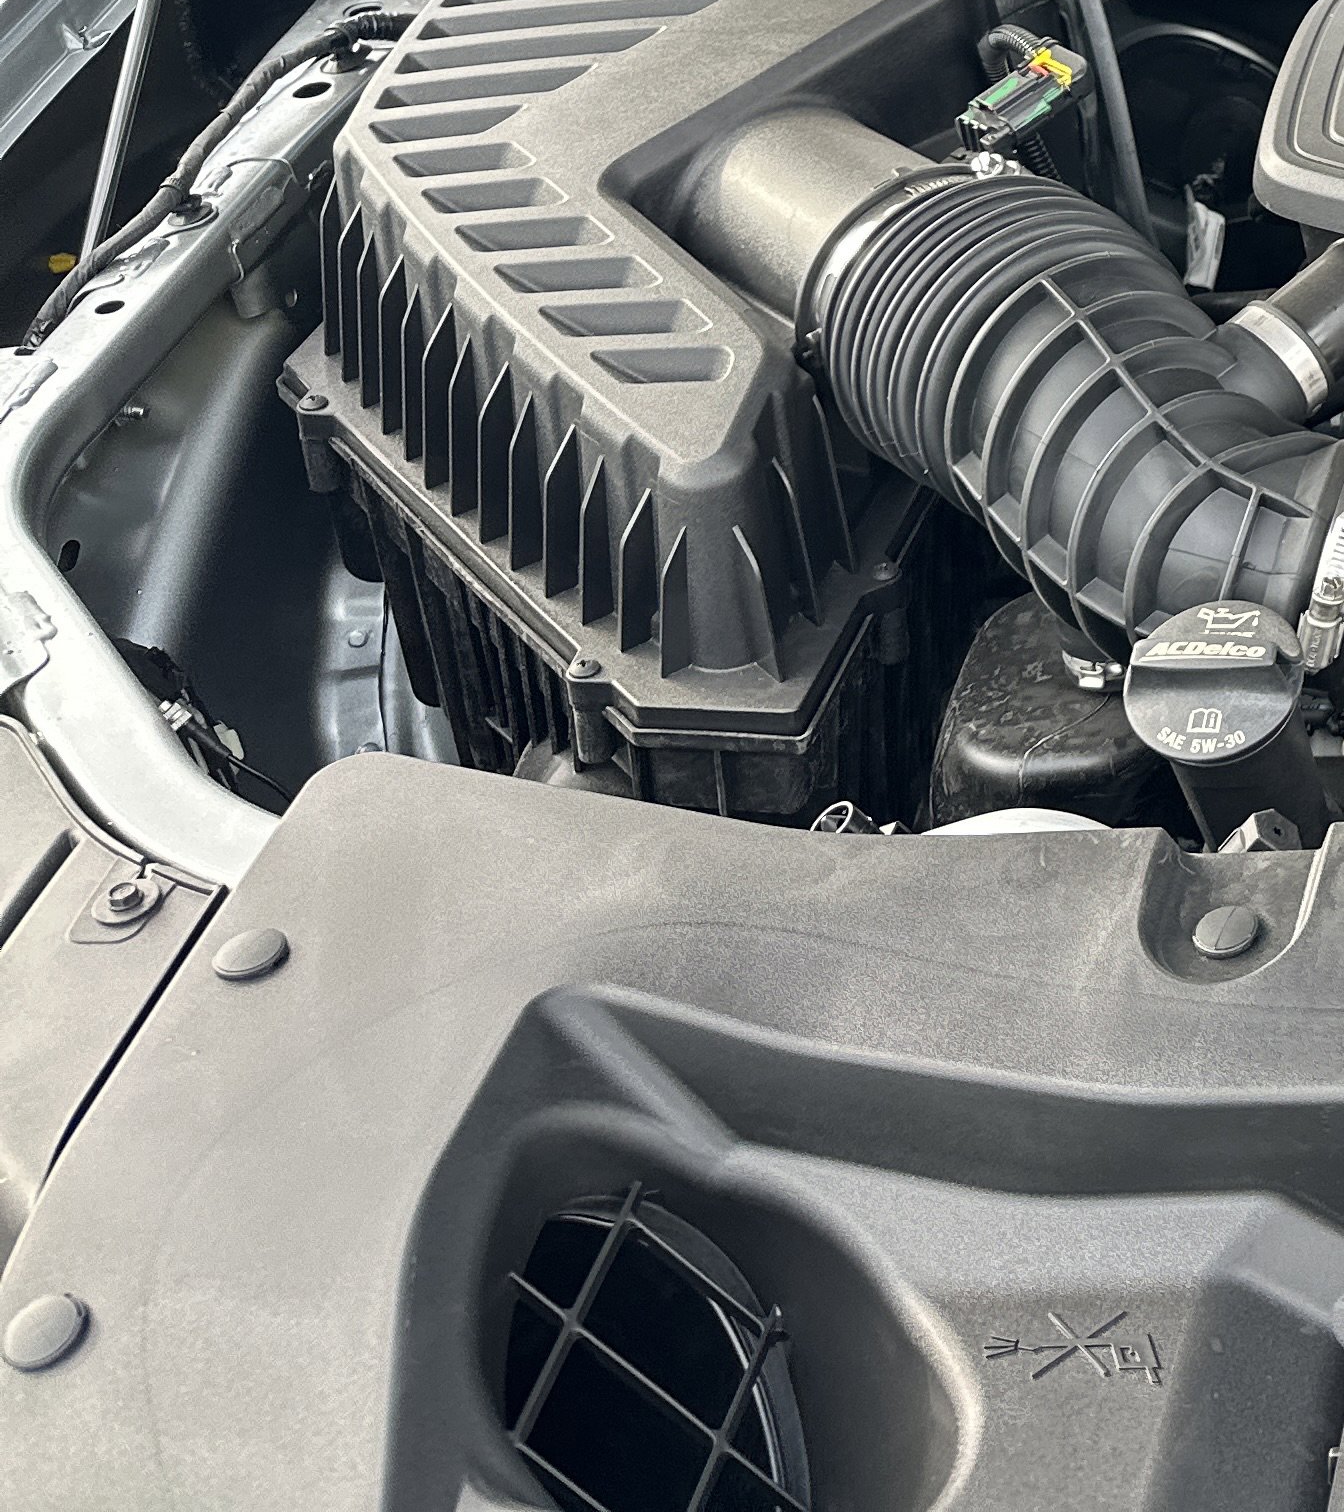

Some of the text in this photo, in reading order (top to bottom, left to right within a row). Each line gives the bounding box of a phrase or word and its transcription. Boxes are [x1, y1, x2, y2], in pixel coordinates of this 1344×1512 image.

[1145, 641, 1266, 658] ACDelco
[1156, 726, 1246, 754] SAE 5W-30
